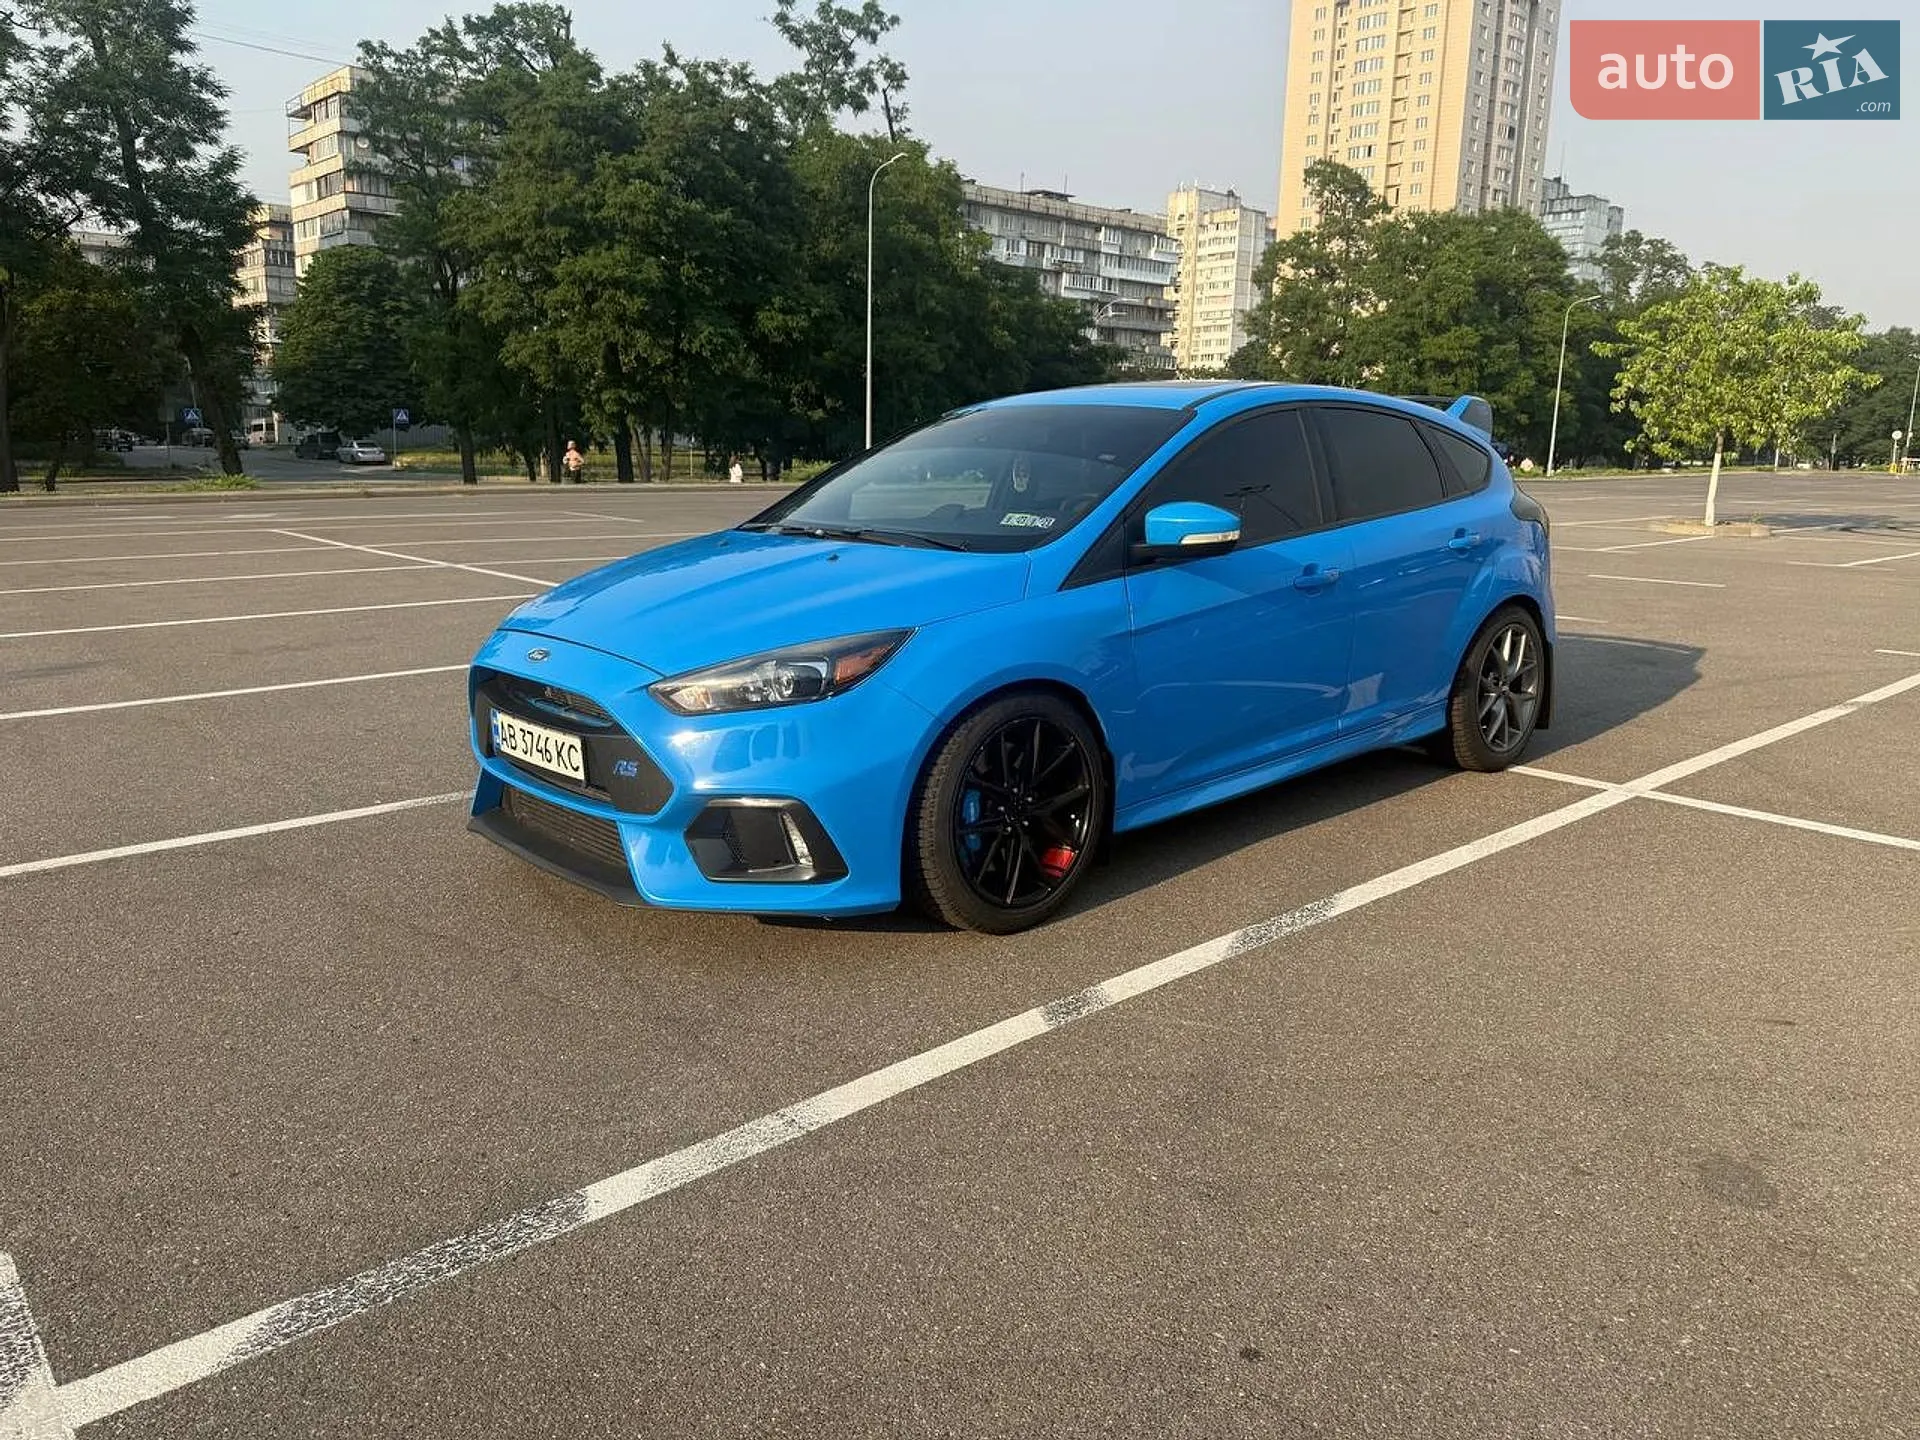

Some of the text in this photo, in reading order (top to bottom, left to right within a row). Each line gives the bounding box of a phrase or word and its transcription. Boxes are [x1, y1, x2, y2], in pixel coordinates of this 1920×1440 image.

[501, 720, 580, 772] AB 3746 KC
